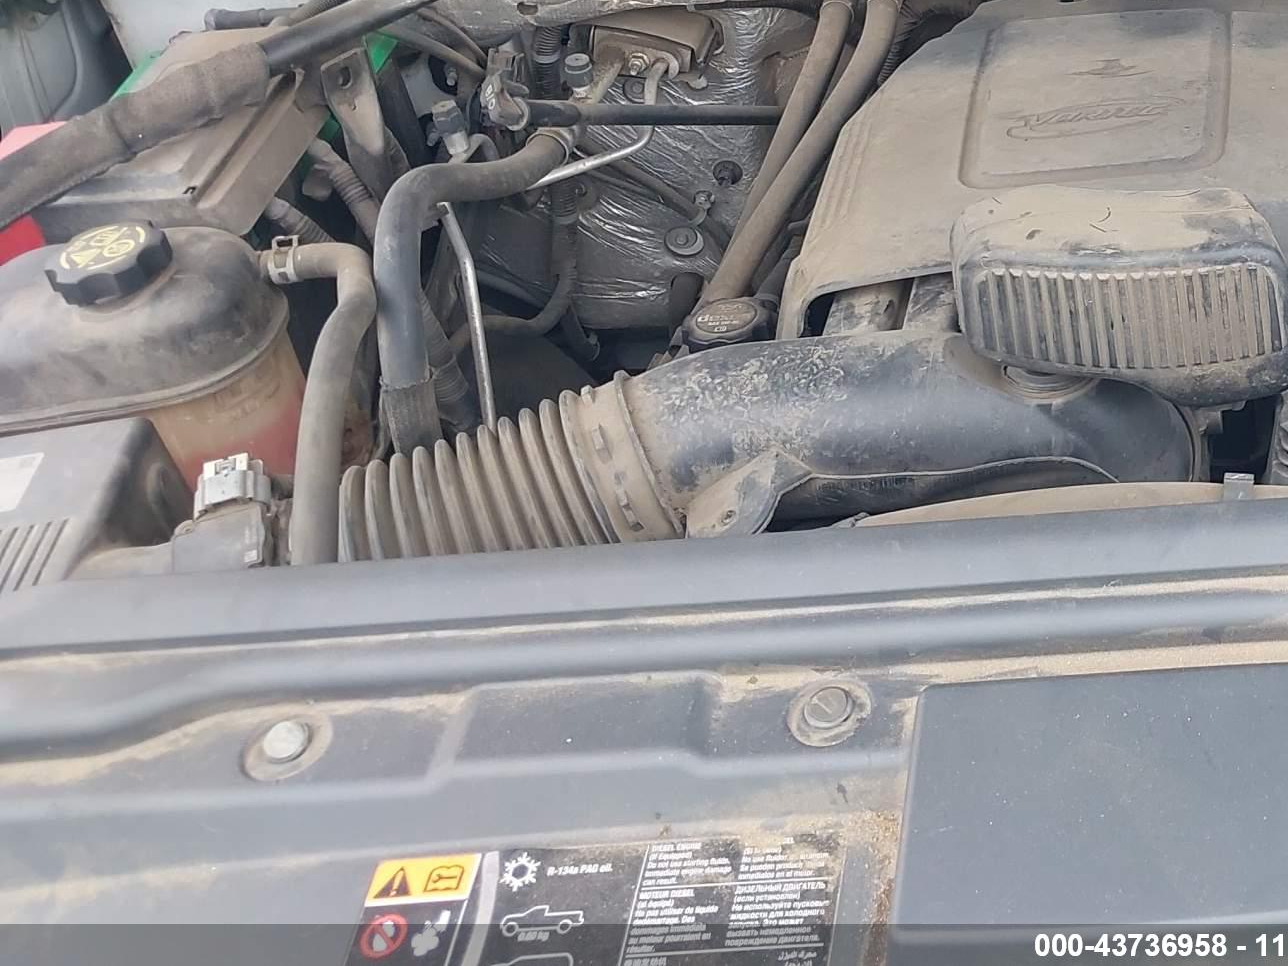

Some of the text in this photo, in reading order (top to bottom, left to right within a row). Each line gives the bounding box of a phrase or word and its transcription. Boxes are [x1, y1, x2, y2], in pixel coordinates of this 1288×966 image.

[658, 860, 669, 868] not
[683, 859, 709, 868] starting
[782, 882, 826, 891] ДВИГАТЕЛЬ
[670, 888, 695, 898] DIESEL
[646, 910, 659, 918] pas
[684, 906, 694, 914] de
[694, 905, 719, 914] liquide
[762, 918, 777, 926] Это
